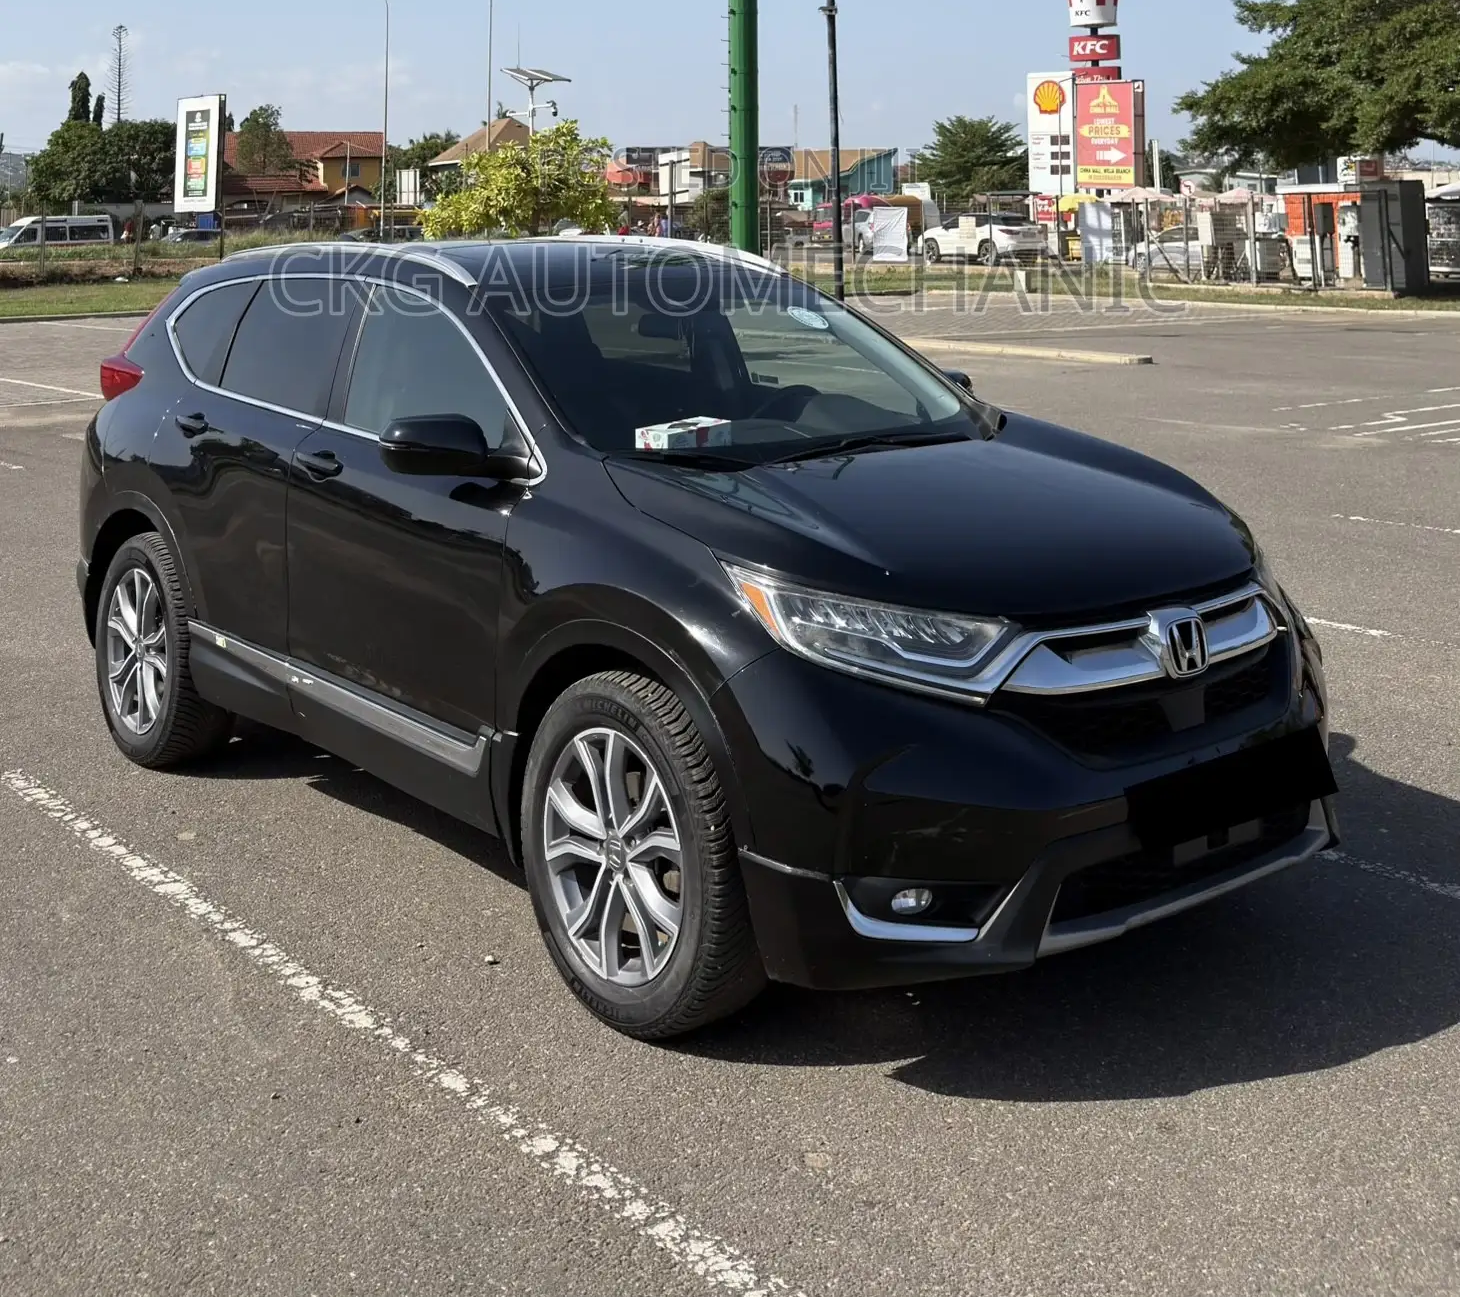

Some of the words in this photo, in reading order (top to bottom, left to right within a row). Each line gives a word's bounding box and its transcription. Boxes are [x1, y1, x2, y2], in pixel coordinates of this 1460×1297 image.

[1074, 9, 1091, 17] KFC
[1072, 40, 1109, 56] KFC
[1093, 117, 1116, 125] LOWEST
[1088, 125, 1121, 136] PRICES
